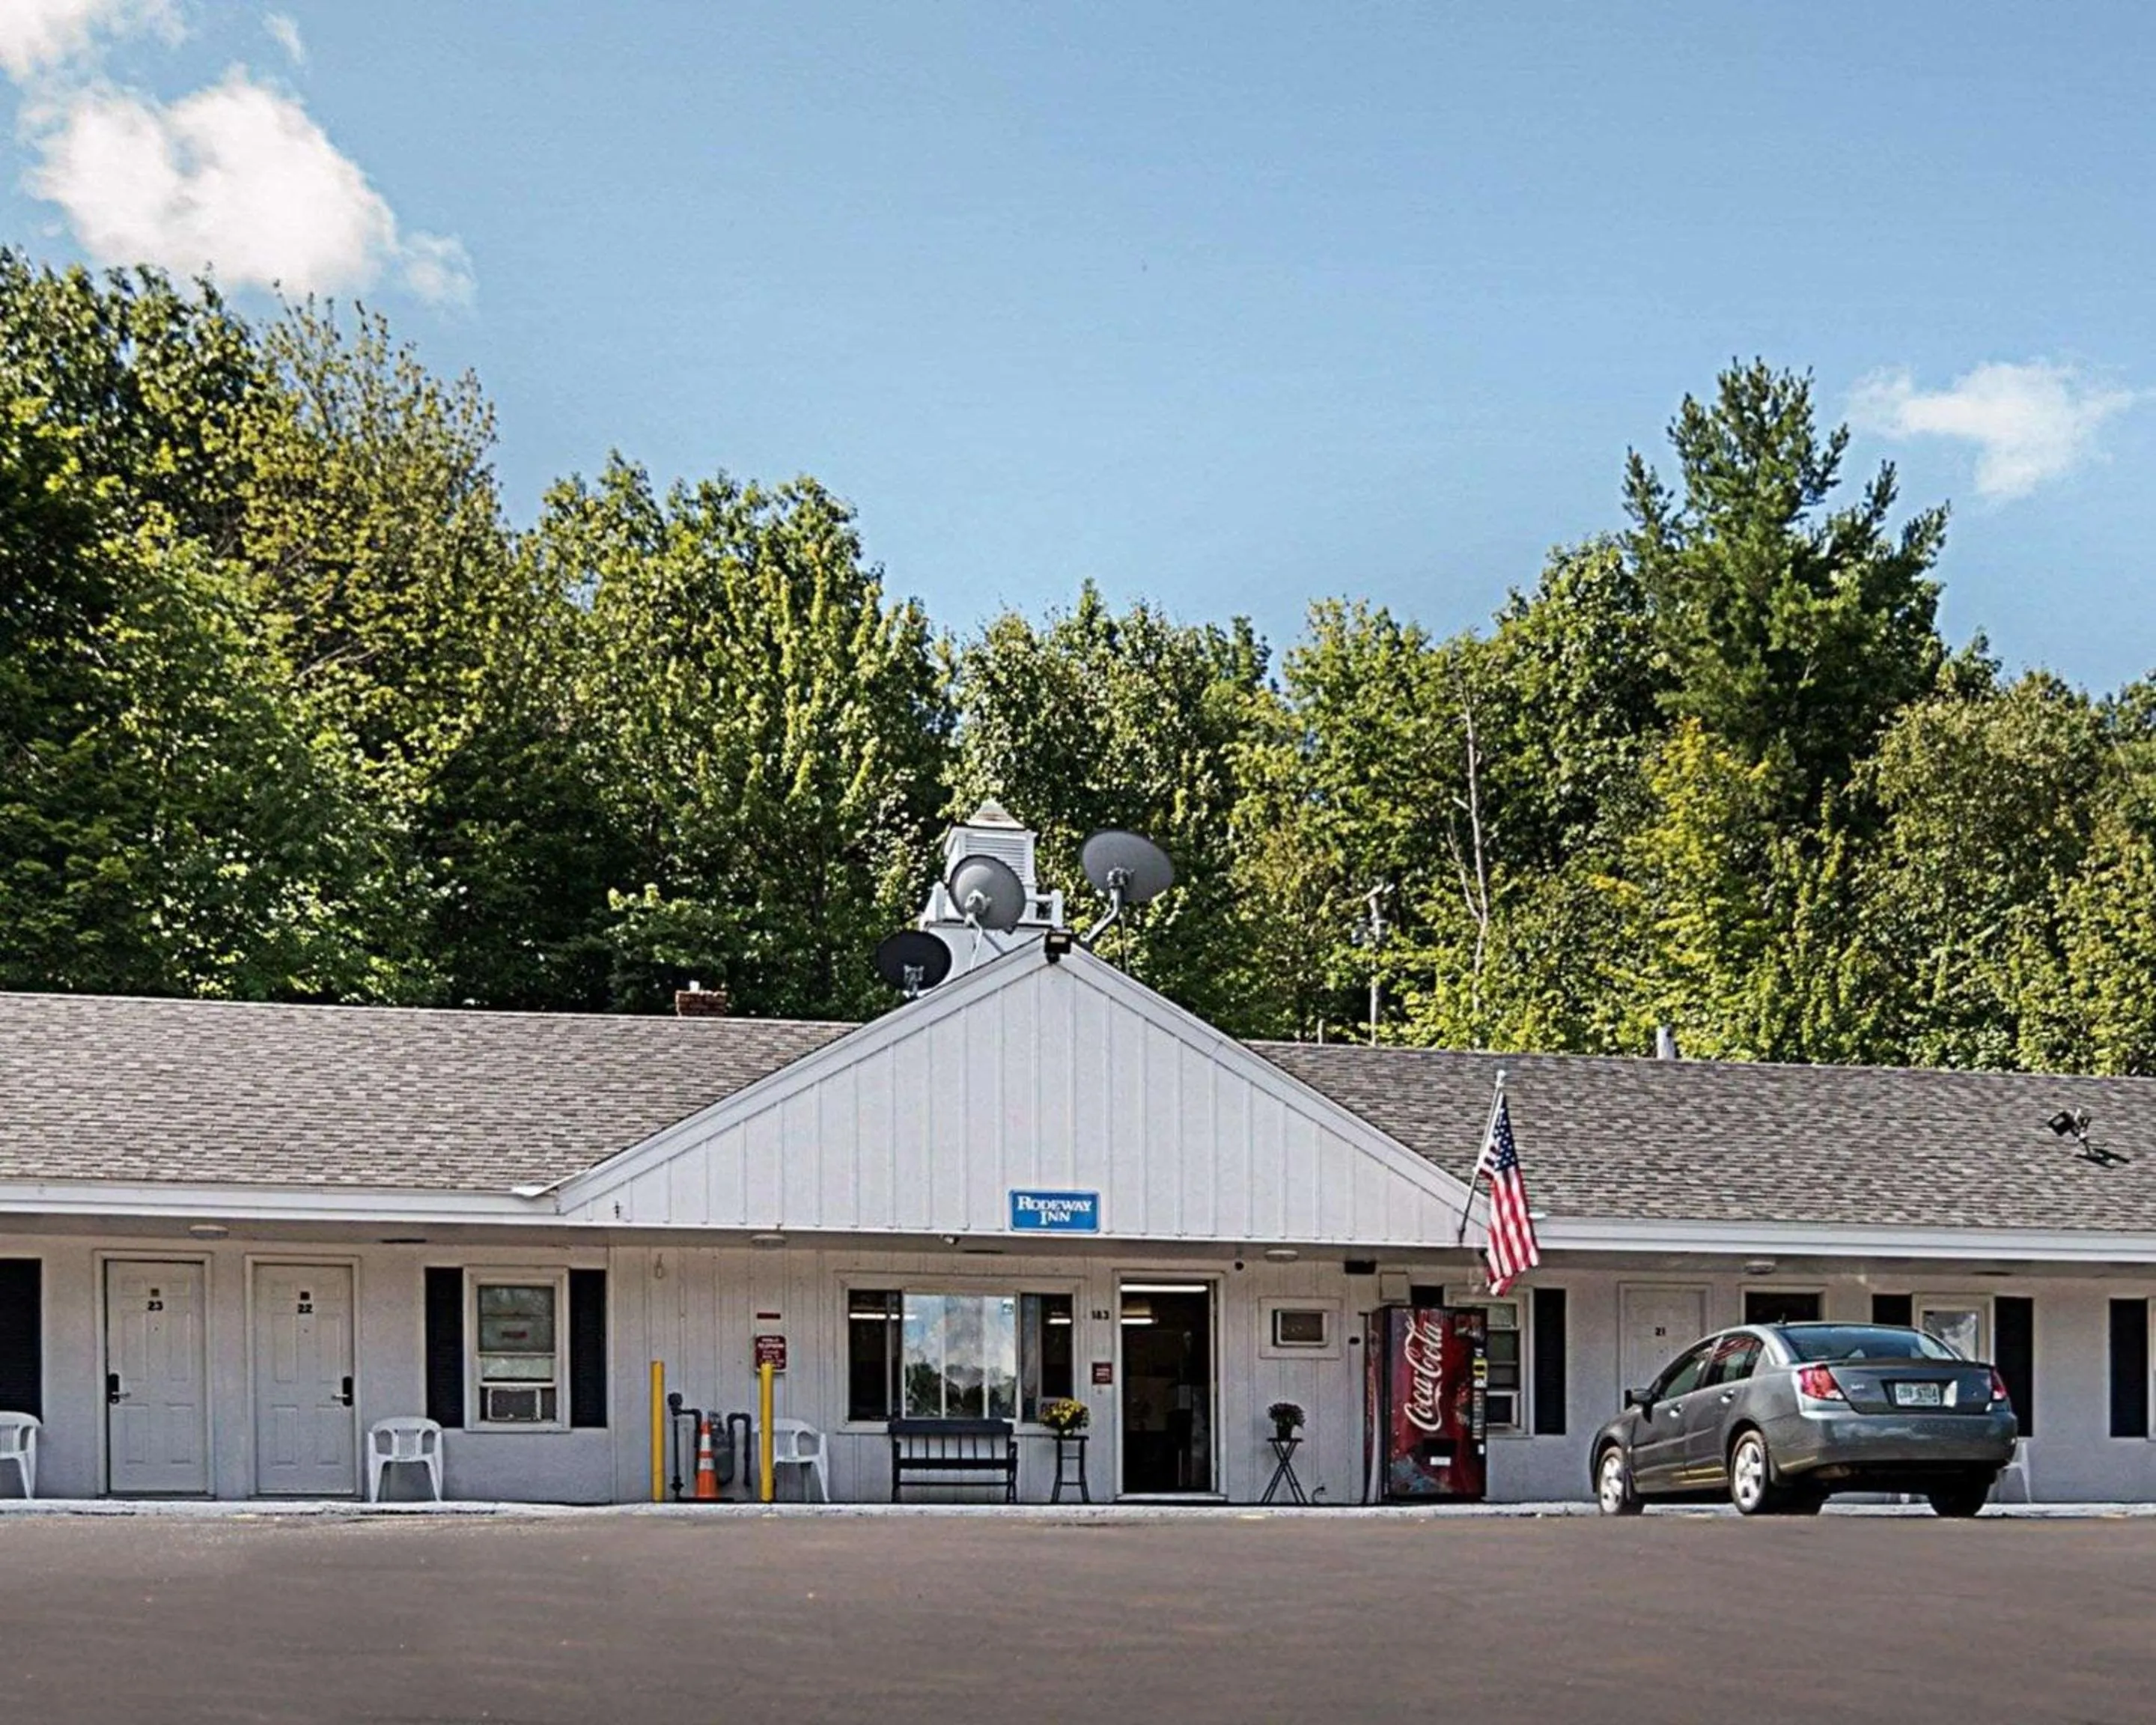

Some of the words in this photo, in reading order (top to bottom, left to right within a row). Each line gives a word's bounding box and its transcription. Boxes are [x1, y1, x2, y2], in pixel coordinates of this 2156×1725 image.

[1017, 1196, 1092, 1211] RODEWAY
[1039, 1210, 1071, 1226] INN
[148, 1300, 163, 1311] 23
[298, 1303, 313, 1314] 22
